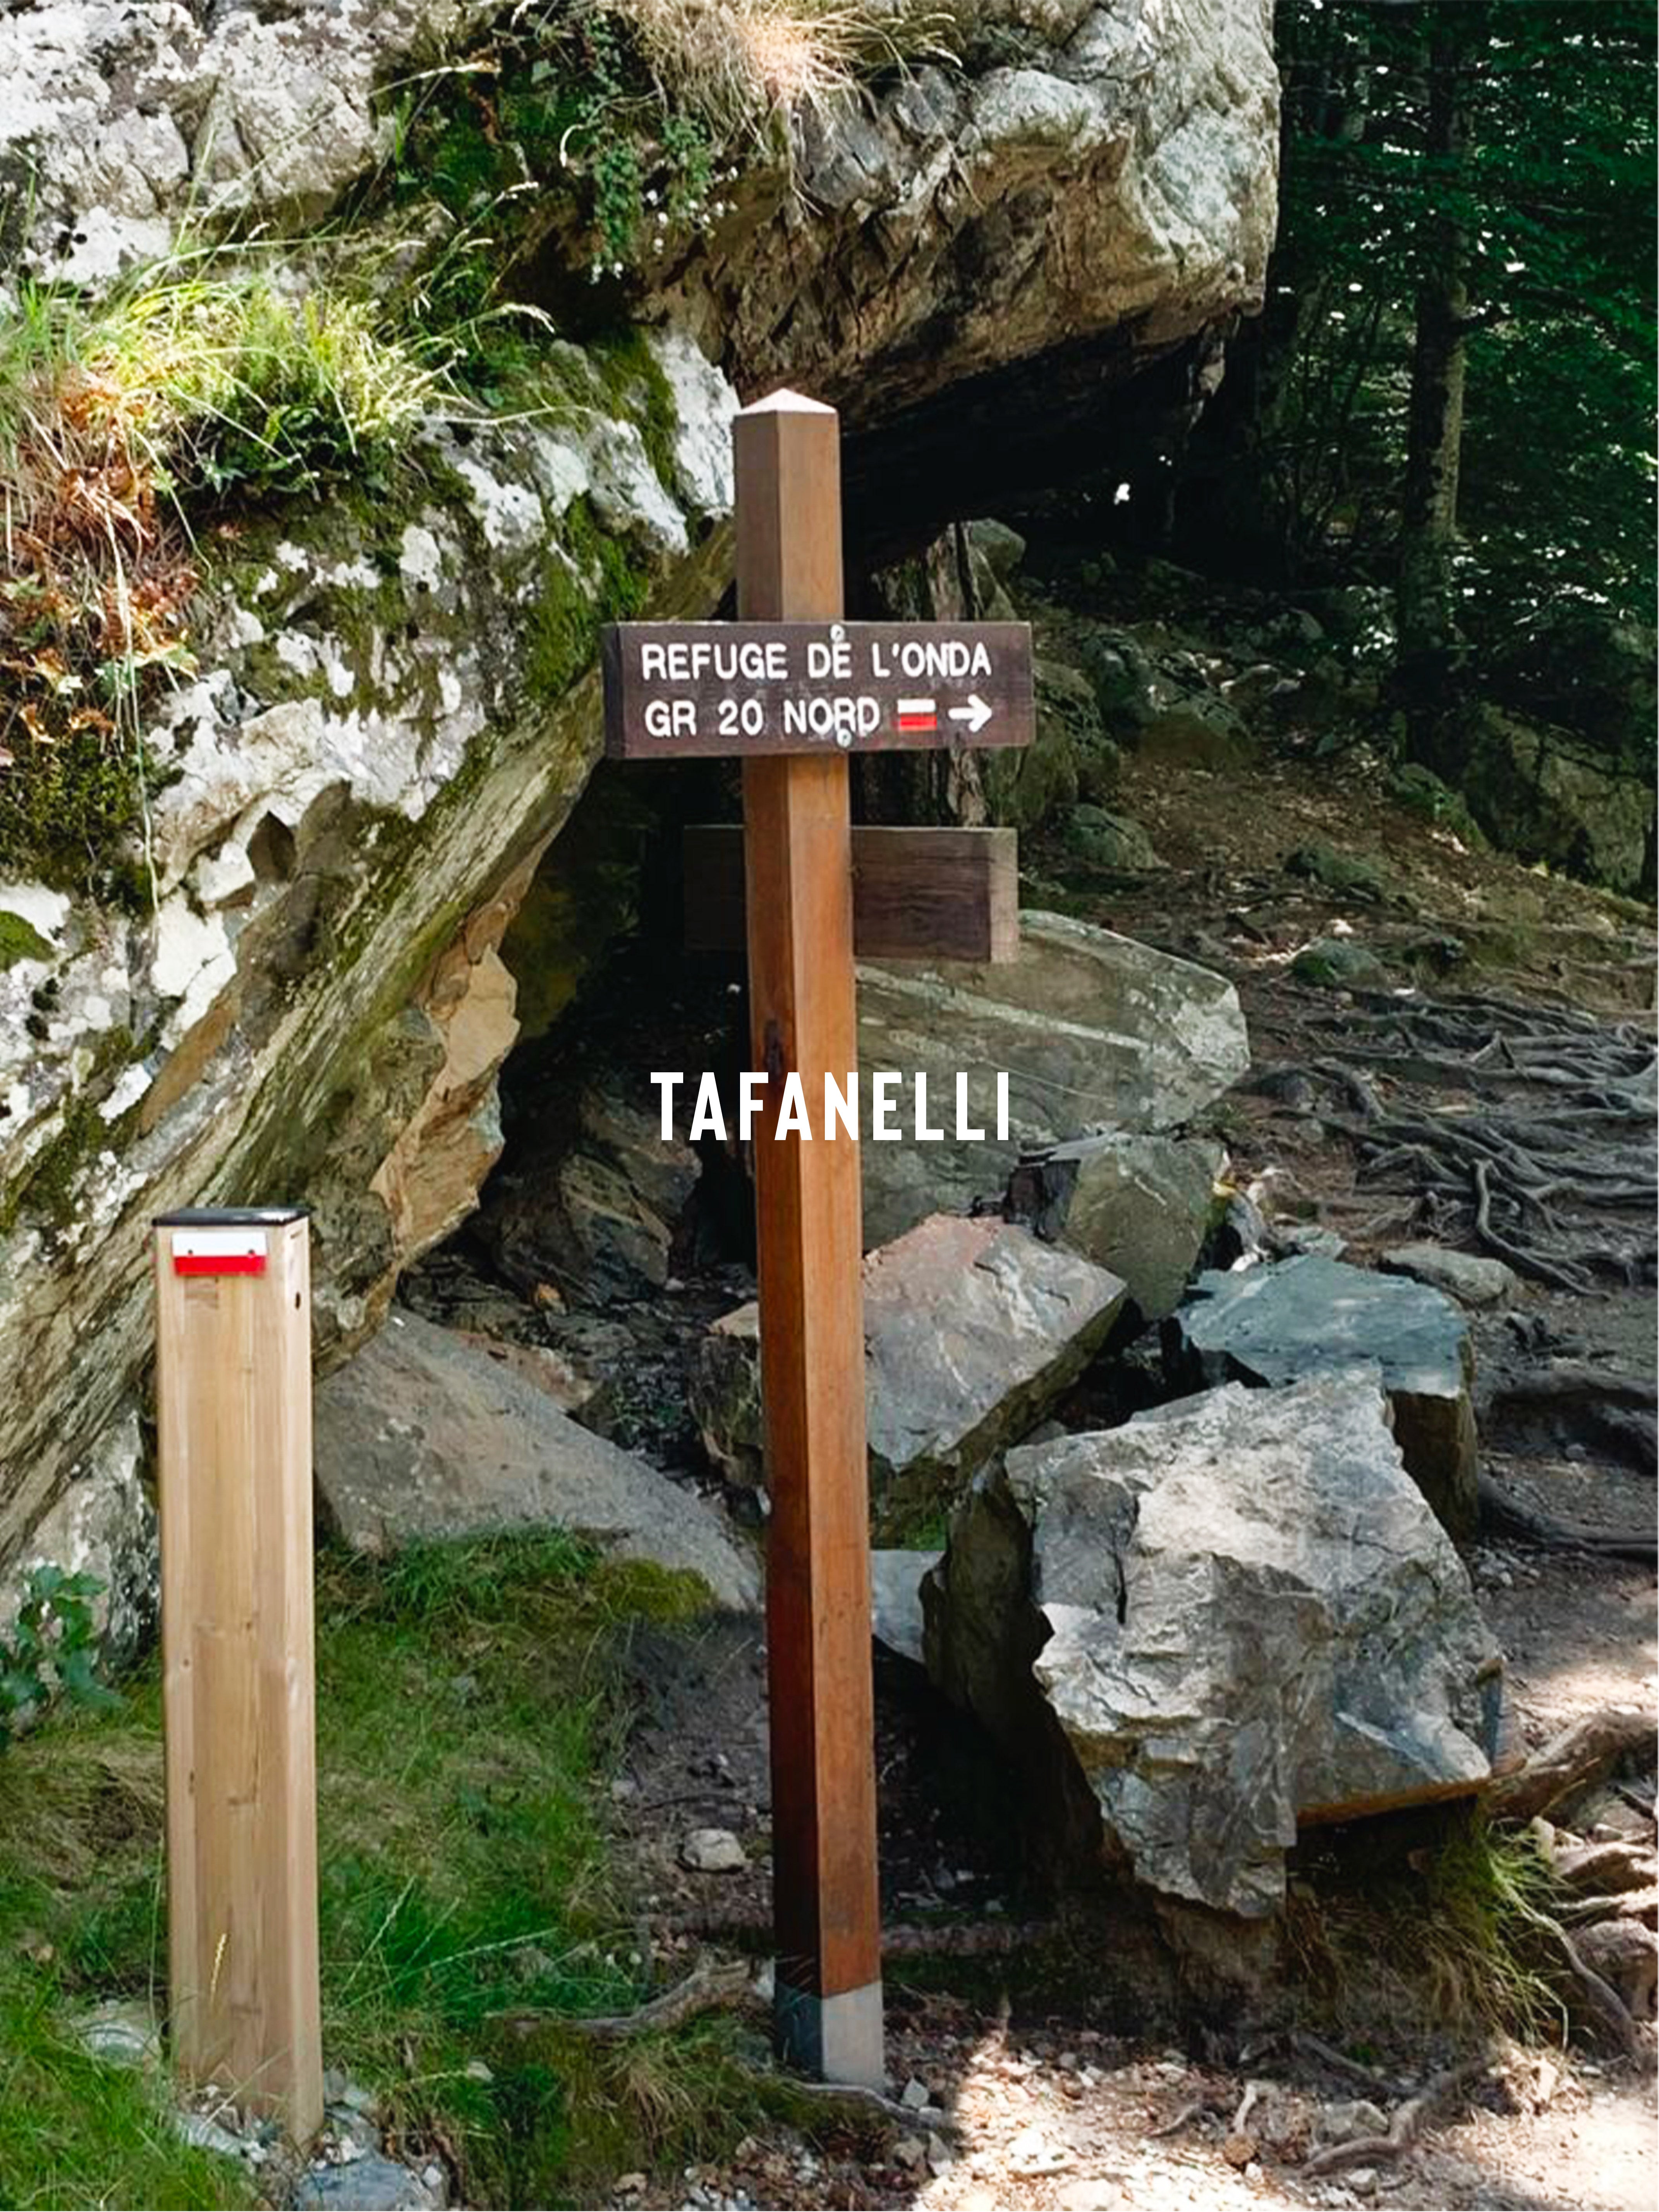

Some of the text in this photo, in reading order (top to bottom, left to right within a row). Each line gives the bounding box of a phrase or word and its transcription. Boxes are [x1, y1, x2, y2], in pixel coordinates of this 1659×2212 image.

[642, 641, 992, 680] REFUGE DE L'ONDA
[645, 697, 880, 737] GR 20 NORD
